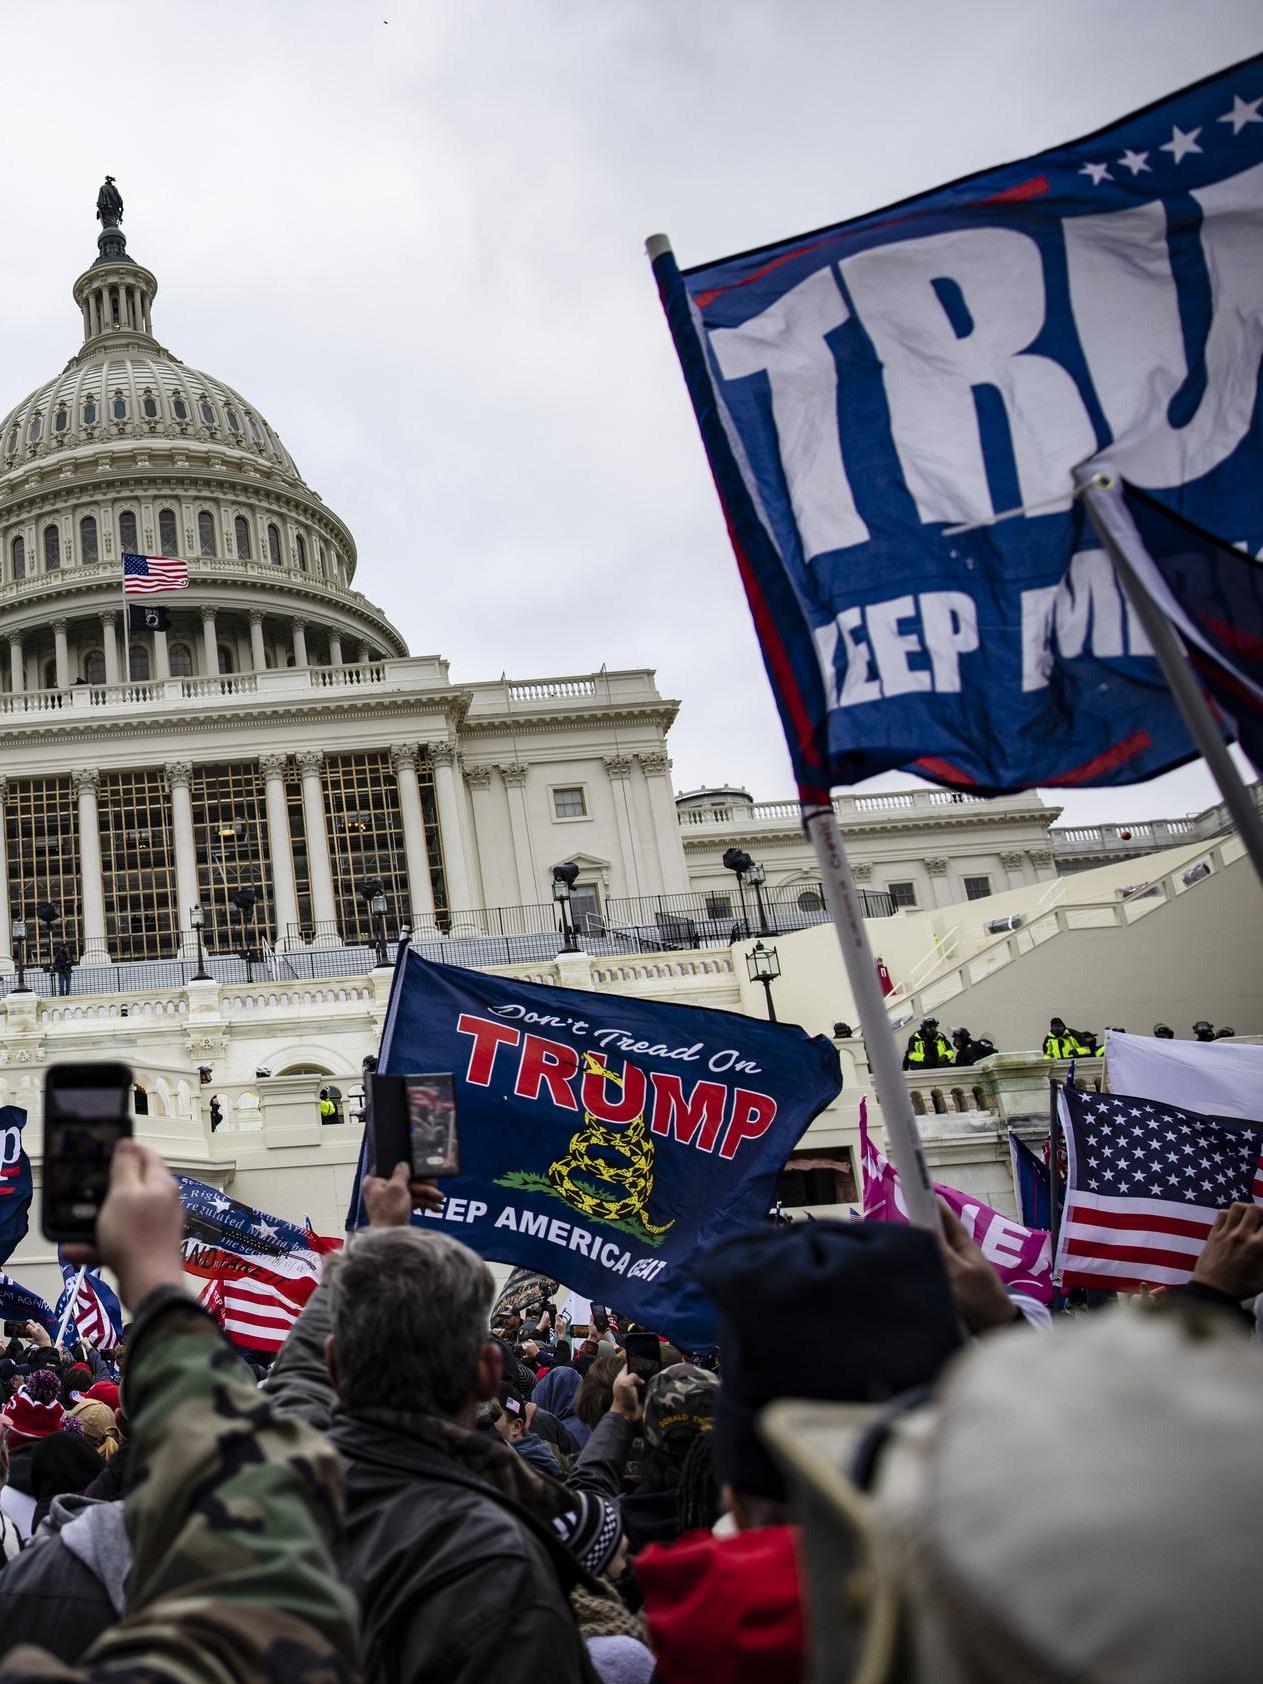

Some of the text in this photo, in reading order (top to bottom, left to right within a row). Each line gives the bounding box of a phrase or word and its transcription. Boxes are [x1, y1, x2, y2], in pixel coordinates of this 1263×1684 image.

[487, 1004, 762, 1074] Don't Tread On
[456, 1013, 777, 1160] TRUMP
[413, 1197, 488, 1223] EEP
[494, 1206, 631, 1275] AMERICA
